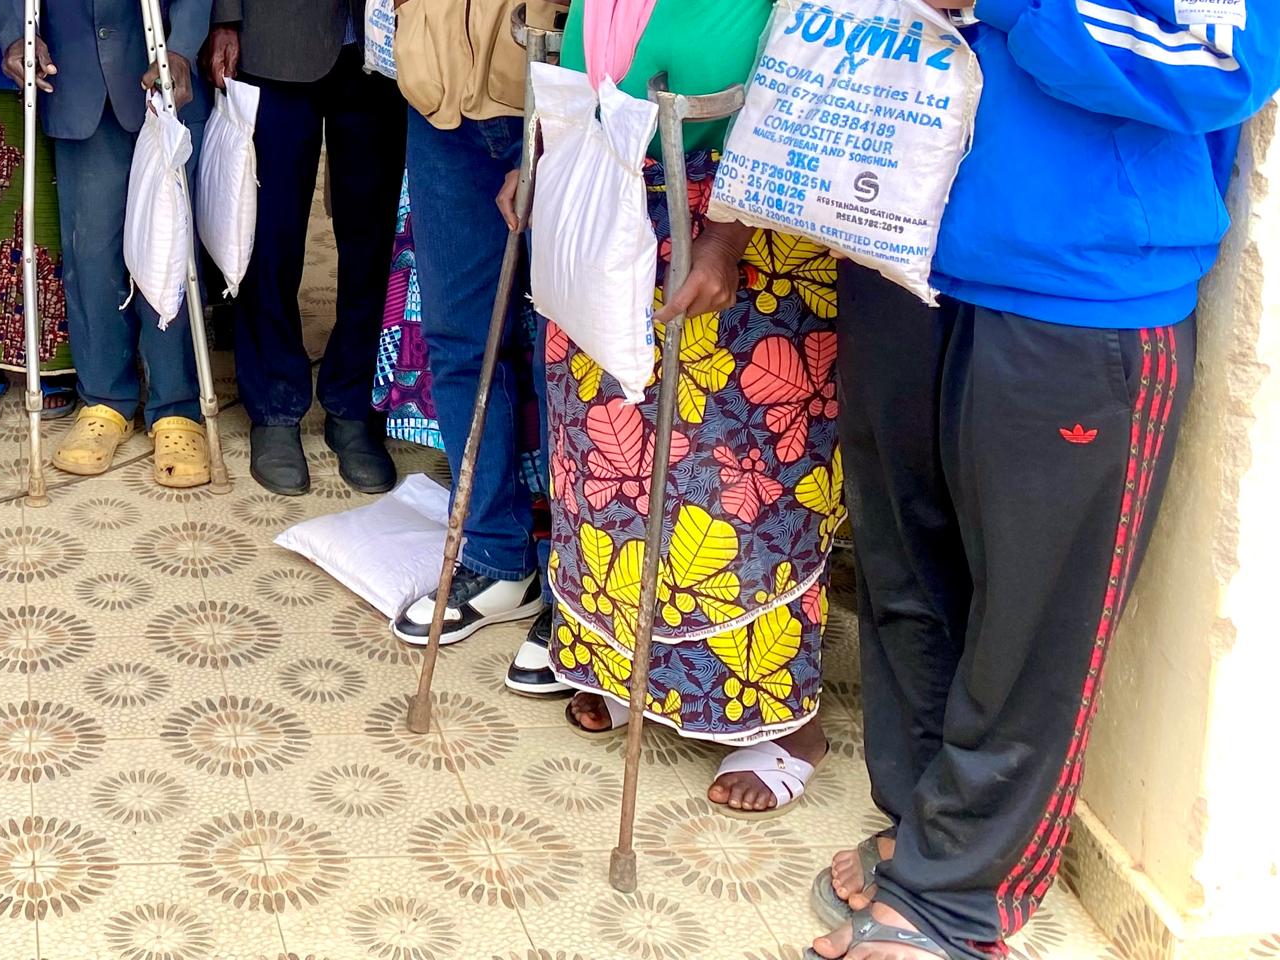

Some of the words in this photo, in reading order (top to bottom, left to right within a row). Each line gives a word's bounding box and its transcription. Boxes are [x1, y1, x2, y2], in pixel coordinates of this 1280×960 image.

[783, 2, 924, 63] SOSOMA
[925, 34, 962, 71] 2
[760, 55, 825, 88] SOSOMA
[914, 90, 951, 110] Ltd
[764, 115, 843, 145] COMPOSITE
[845, 133, 894, 155] FLOUR
[786, 149, 820, 172] 3KG
[821, 145, 846, 158] AND
[849, 152, 898, 169] SORGHUM
[744, 189, 805, 217] 24/08/27
[747, 173, 807, 202] 25/08/26
[819, 225, 871, 247] CERTIFIED
[873, 239, 930, 258] COMPANY
